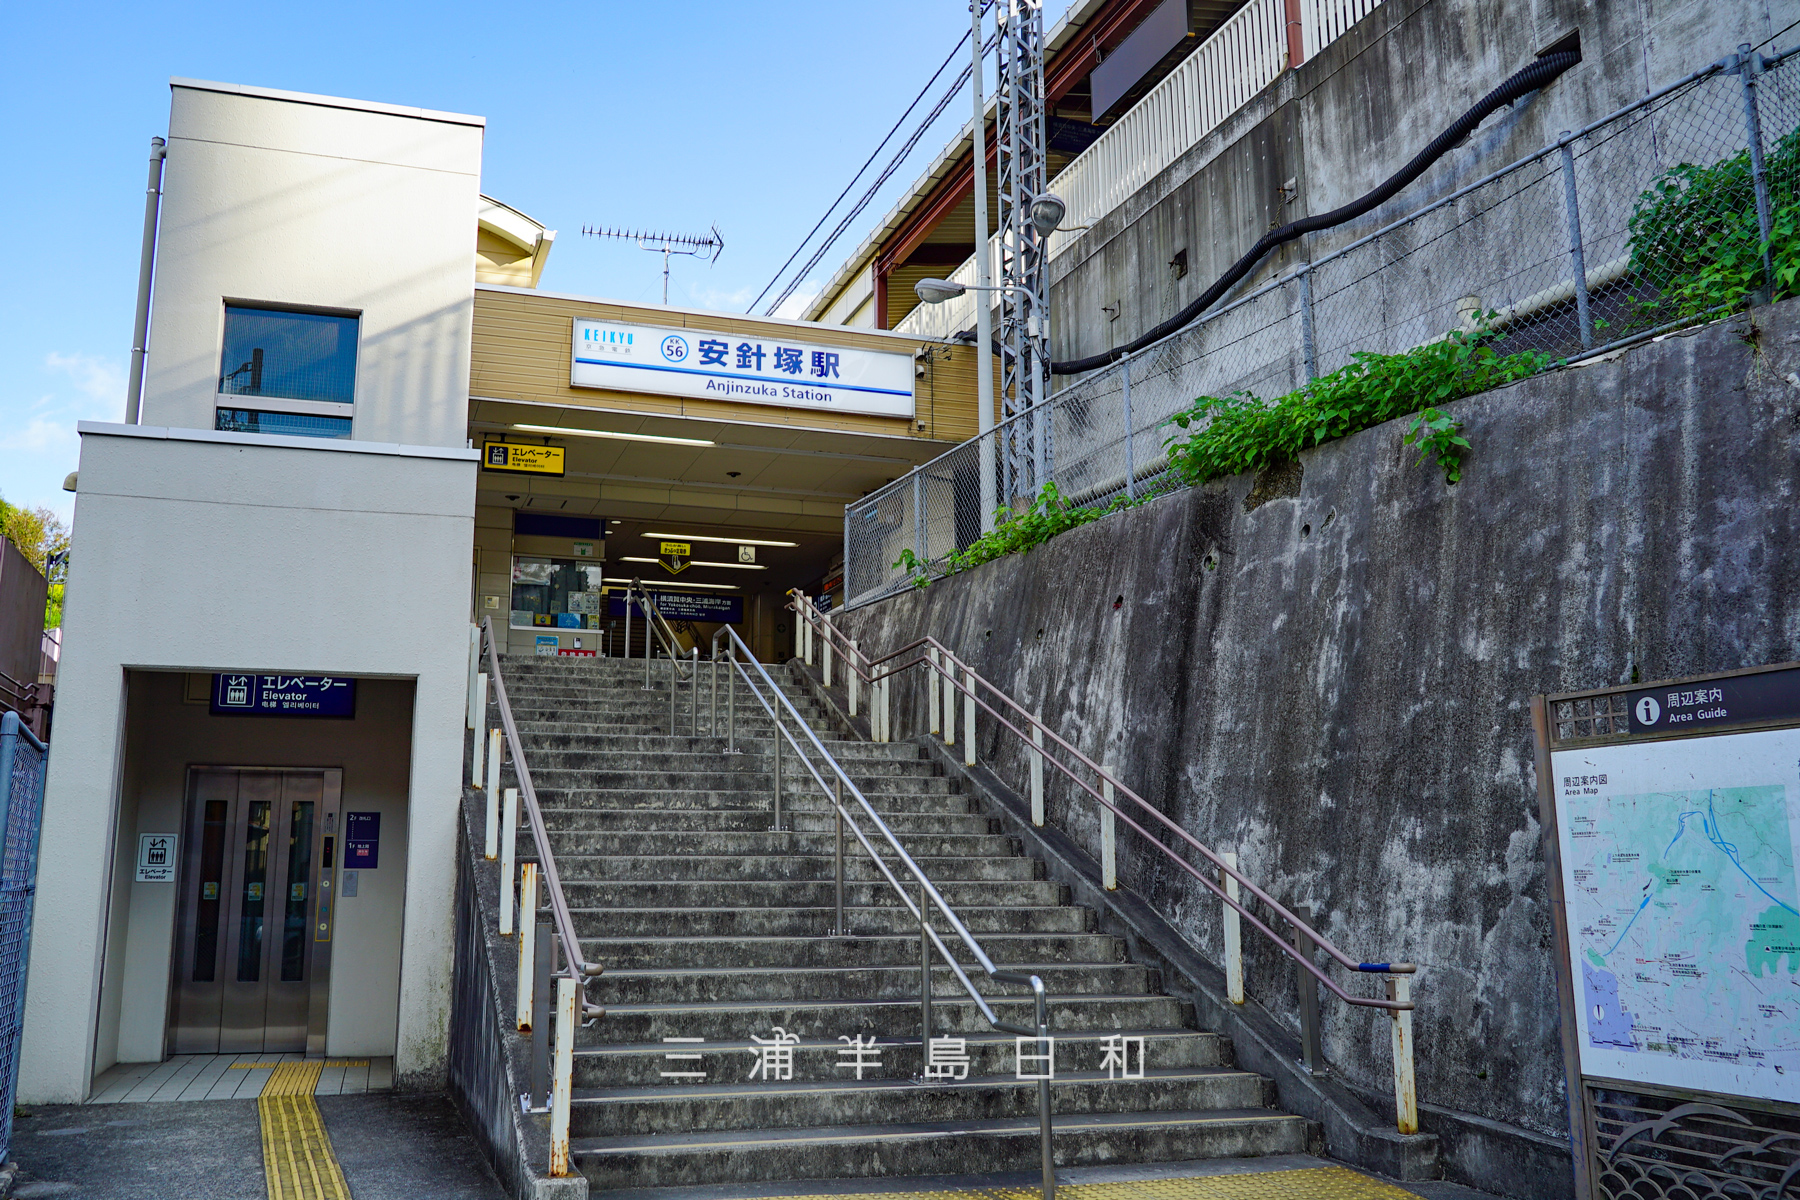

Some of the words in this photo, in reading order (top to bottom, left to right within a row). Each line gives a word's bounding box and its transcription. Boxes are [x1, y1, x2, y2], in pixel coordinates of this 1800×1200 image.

[584, 328, 633, 345] KEIKYU
[666, 345, 683, 357] 56
[698, 339, 840, 379] 安針塚駅
[706, 379, 777, 397] Anjinzuka
[782, 387, 832, 402] Station
[512, 448, 560, 458] エレベーター
[262, 676, 347, 691] エレベーター
[262, 691, 307, 701] Elevator
[1667, 687, 1723, 708] 周辺案内
[1669, 713, 1693, 723] Area
[1697, 706, 1727, 720] Guide
[1563, 774, 1607, 787] 周辺案内図
[1565, 788, 1580, 796] Area
[1583, 787, 1598, 796] Map
